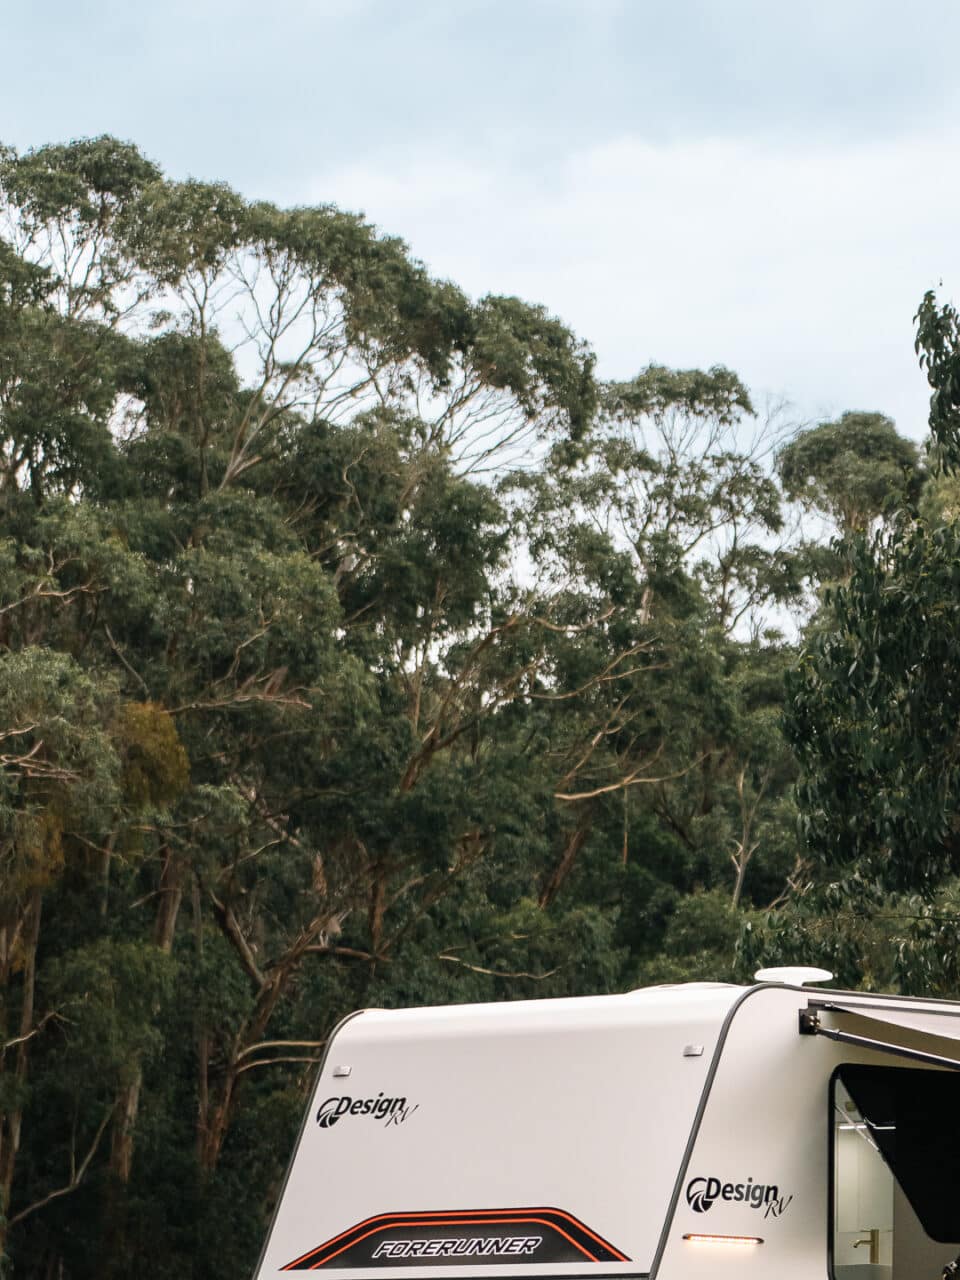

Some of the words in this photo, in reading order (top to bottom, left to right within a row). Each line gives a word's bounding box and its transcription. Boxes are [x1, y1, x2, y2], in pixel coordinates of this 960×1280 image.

[335, 1092, 407, 1119] Design
[384, 1103, 420, 1128] RV
[705, 1177, 779, 1209] Design
[763, 1194, 794, 1220] RV
[371, 1236, 543, 1259] FORERUNNER
